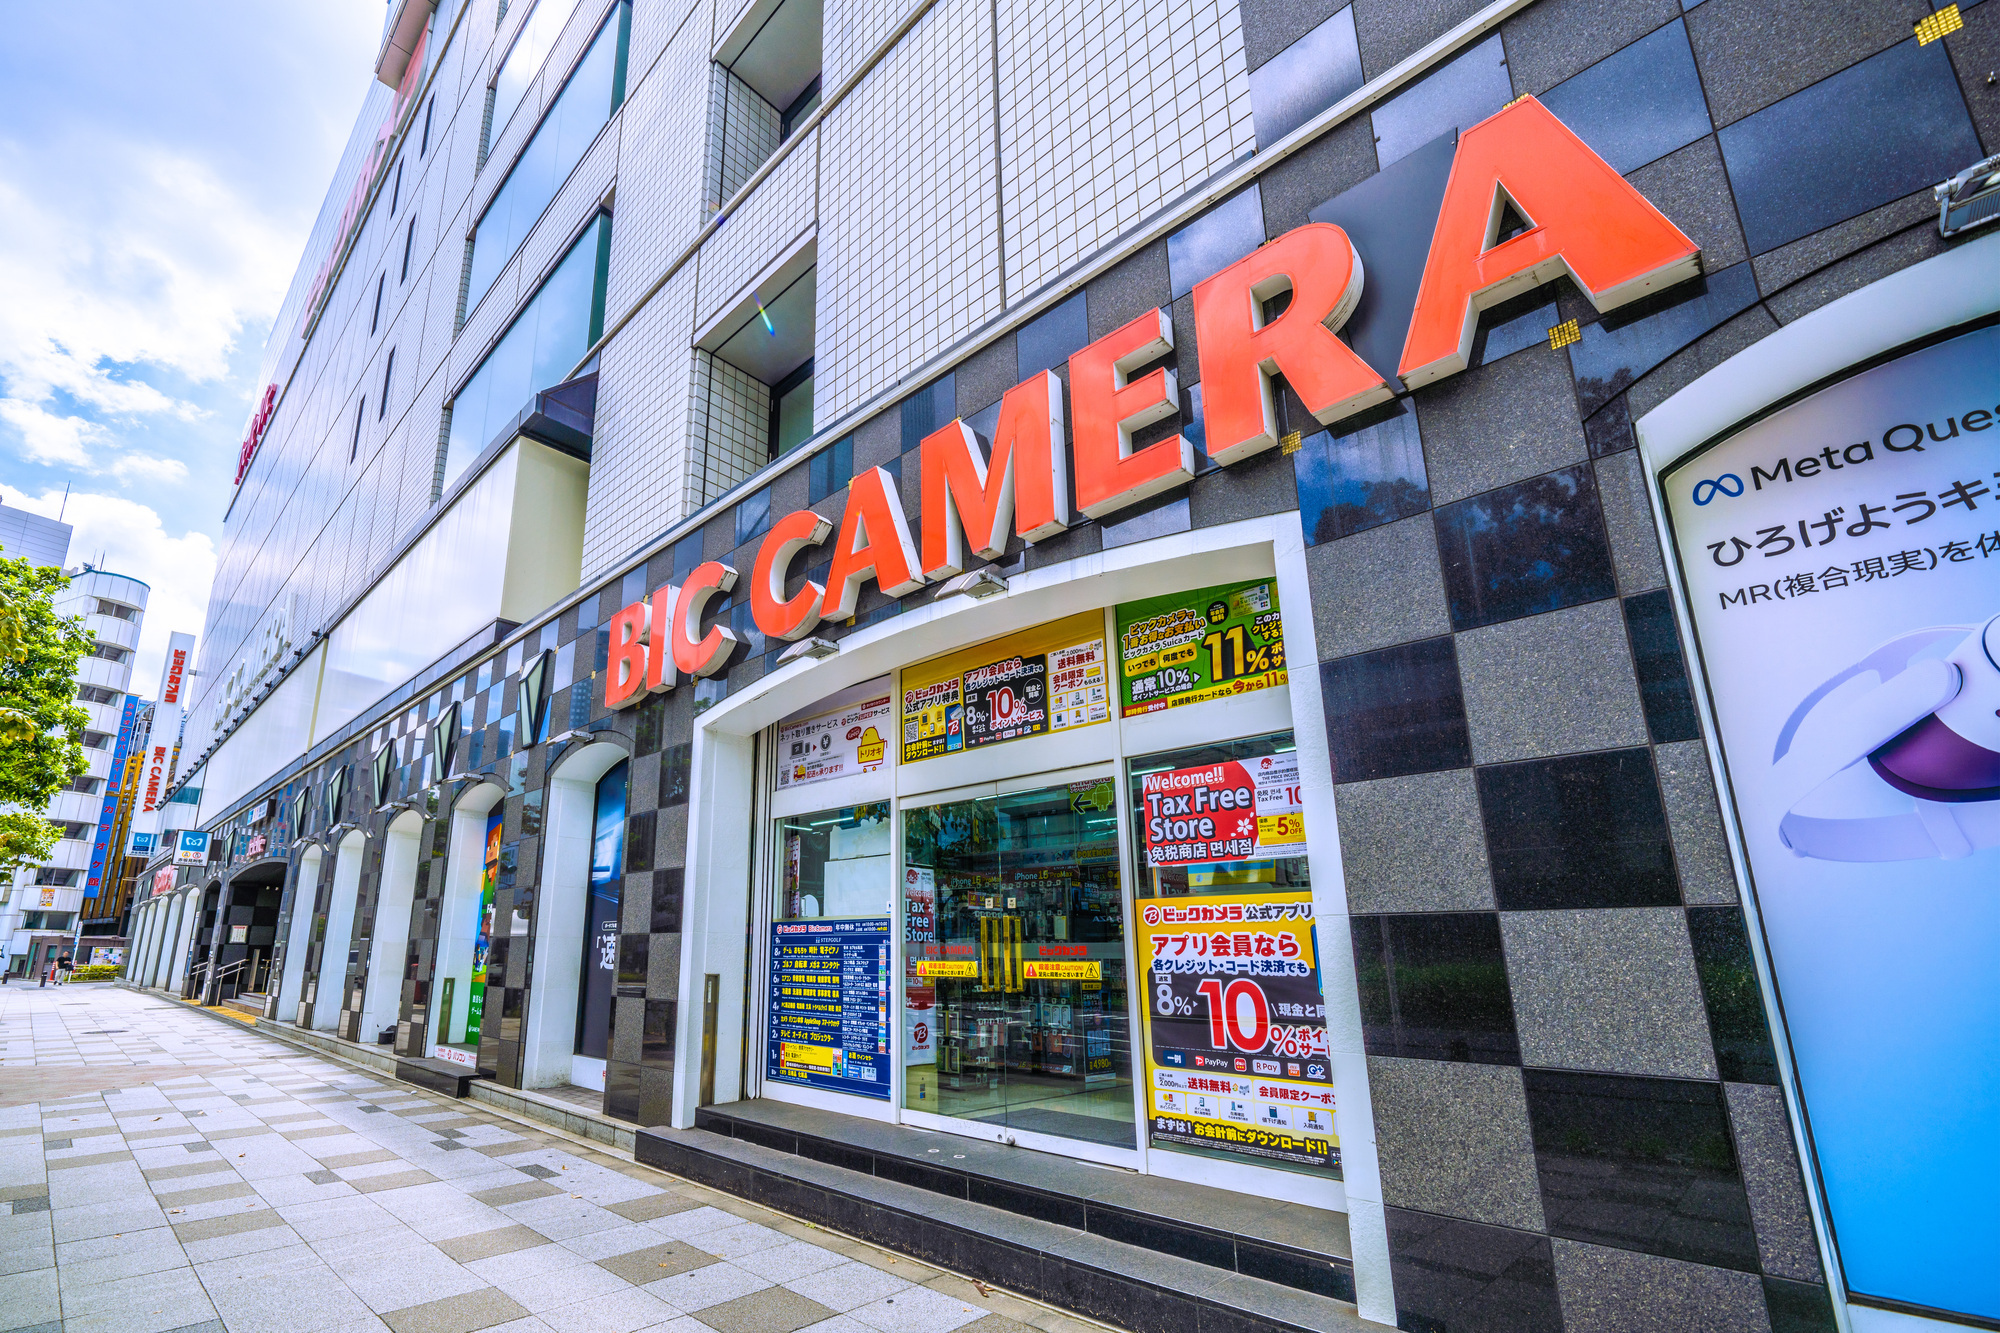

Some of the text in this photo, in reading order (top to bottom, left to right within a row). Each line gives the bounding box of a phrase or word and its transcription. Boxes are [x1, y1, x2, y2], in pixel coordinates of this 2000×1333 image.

[605, 93, 1702, 712] BIC CAMERA
[1750, 441, 1874, 491] Meta
[1130, 610, 1195, 636] ビックカメラで
[1122, 618, 1206, 650] 1番お得なお支払い
[1124, 631, 1205, 658] ビックカメラ Suica カード
[1203, 626, 1269, 681] 11%
[1057, 650, 1095, 670] 送料無料
[1128, 649, 1194, 672] いつでも 何度でも
[164, 649, 186, 703] ビックカメラ
[965, 658, 1022, 683] アプリ会員なら
[965, 665, 1043, 691] 各クレジット・コード決済でも
[1053, 669, 1084, 684] 会員限定
[915, 679, 959, 700] ビックカメラ
[1053, 679, 1083, 693] クーポン
[1132, 683, 1193, 701] ポイントサービスの場合
[905, 690, 959, 714] 公式アプリ特典
[986, 687, 1026, 721] 10%
[1125, 702, 1165, 716] 即時発行受付中
[966, 706, 986, 725] 8%
[990, 710, 1043, 730] ポイントサービス
[780, 719, 838, 741] ネット取り置きサービス
[860, 748, 882, 758] トリオキ
[906, 741, 932, 752] お会計前に
[906, 744, 944, 760] ダウンロード!!
[143, 746, 167, 813] BIC CAMERA
[1147, 766, 1224, 791] Welcome!!
[1147, 786, 1252, 818] Tax Free
[1150, 816, 1215, 843] Store
[88, 805, 114, 887] カラオケ館
[1210, 838, 1253, 858] 면세점
[1015, 872, 1038, 881] iPhone
[906, 899, 924, 913] Tax
[1163, 902, 1313, 922] ビックカメラ 公式アプリ
[836, 923, 854, 931] 年中無休
[906, 914, 929, 927] Free
[906, 927, 933, 942] Store
[820, 946, 839, 955] 電子ピアノ
[926, 946, 974, 955] BIC CAMERA
[1039, 946, 1087, 956] ビックカメラ
[1152, 934, 1299, 957] アプリ会員なら
[822, 961, 840, 969] コンタクト
[1153, 959, 1308, 974] 各クレジット・コード決済でも
[1156, 984, 1192, 1016] 8%
[1198, 980, 1297, 1055] 10%
[781, 1030, 790, 1038] テレビ
[792, 1031, 808, 1039] オーディオ
[810, 1032, 834, 1042] プロジェクター
[1167, 1054, 1229, 1068] 一例 PayPay
[1262, 1062, 1278, 1072] Pay
[1188, 1077, 1231, 1094] 送料無料
[1157, 1117, 1192, 1133] まずは!
[1194, 1123, 1328, 1155] お会計前にダウンロード!!
